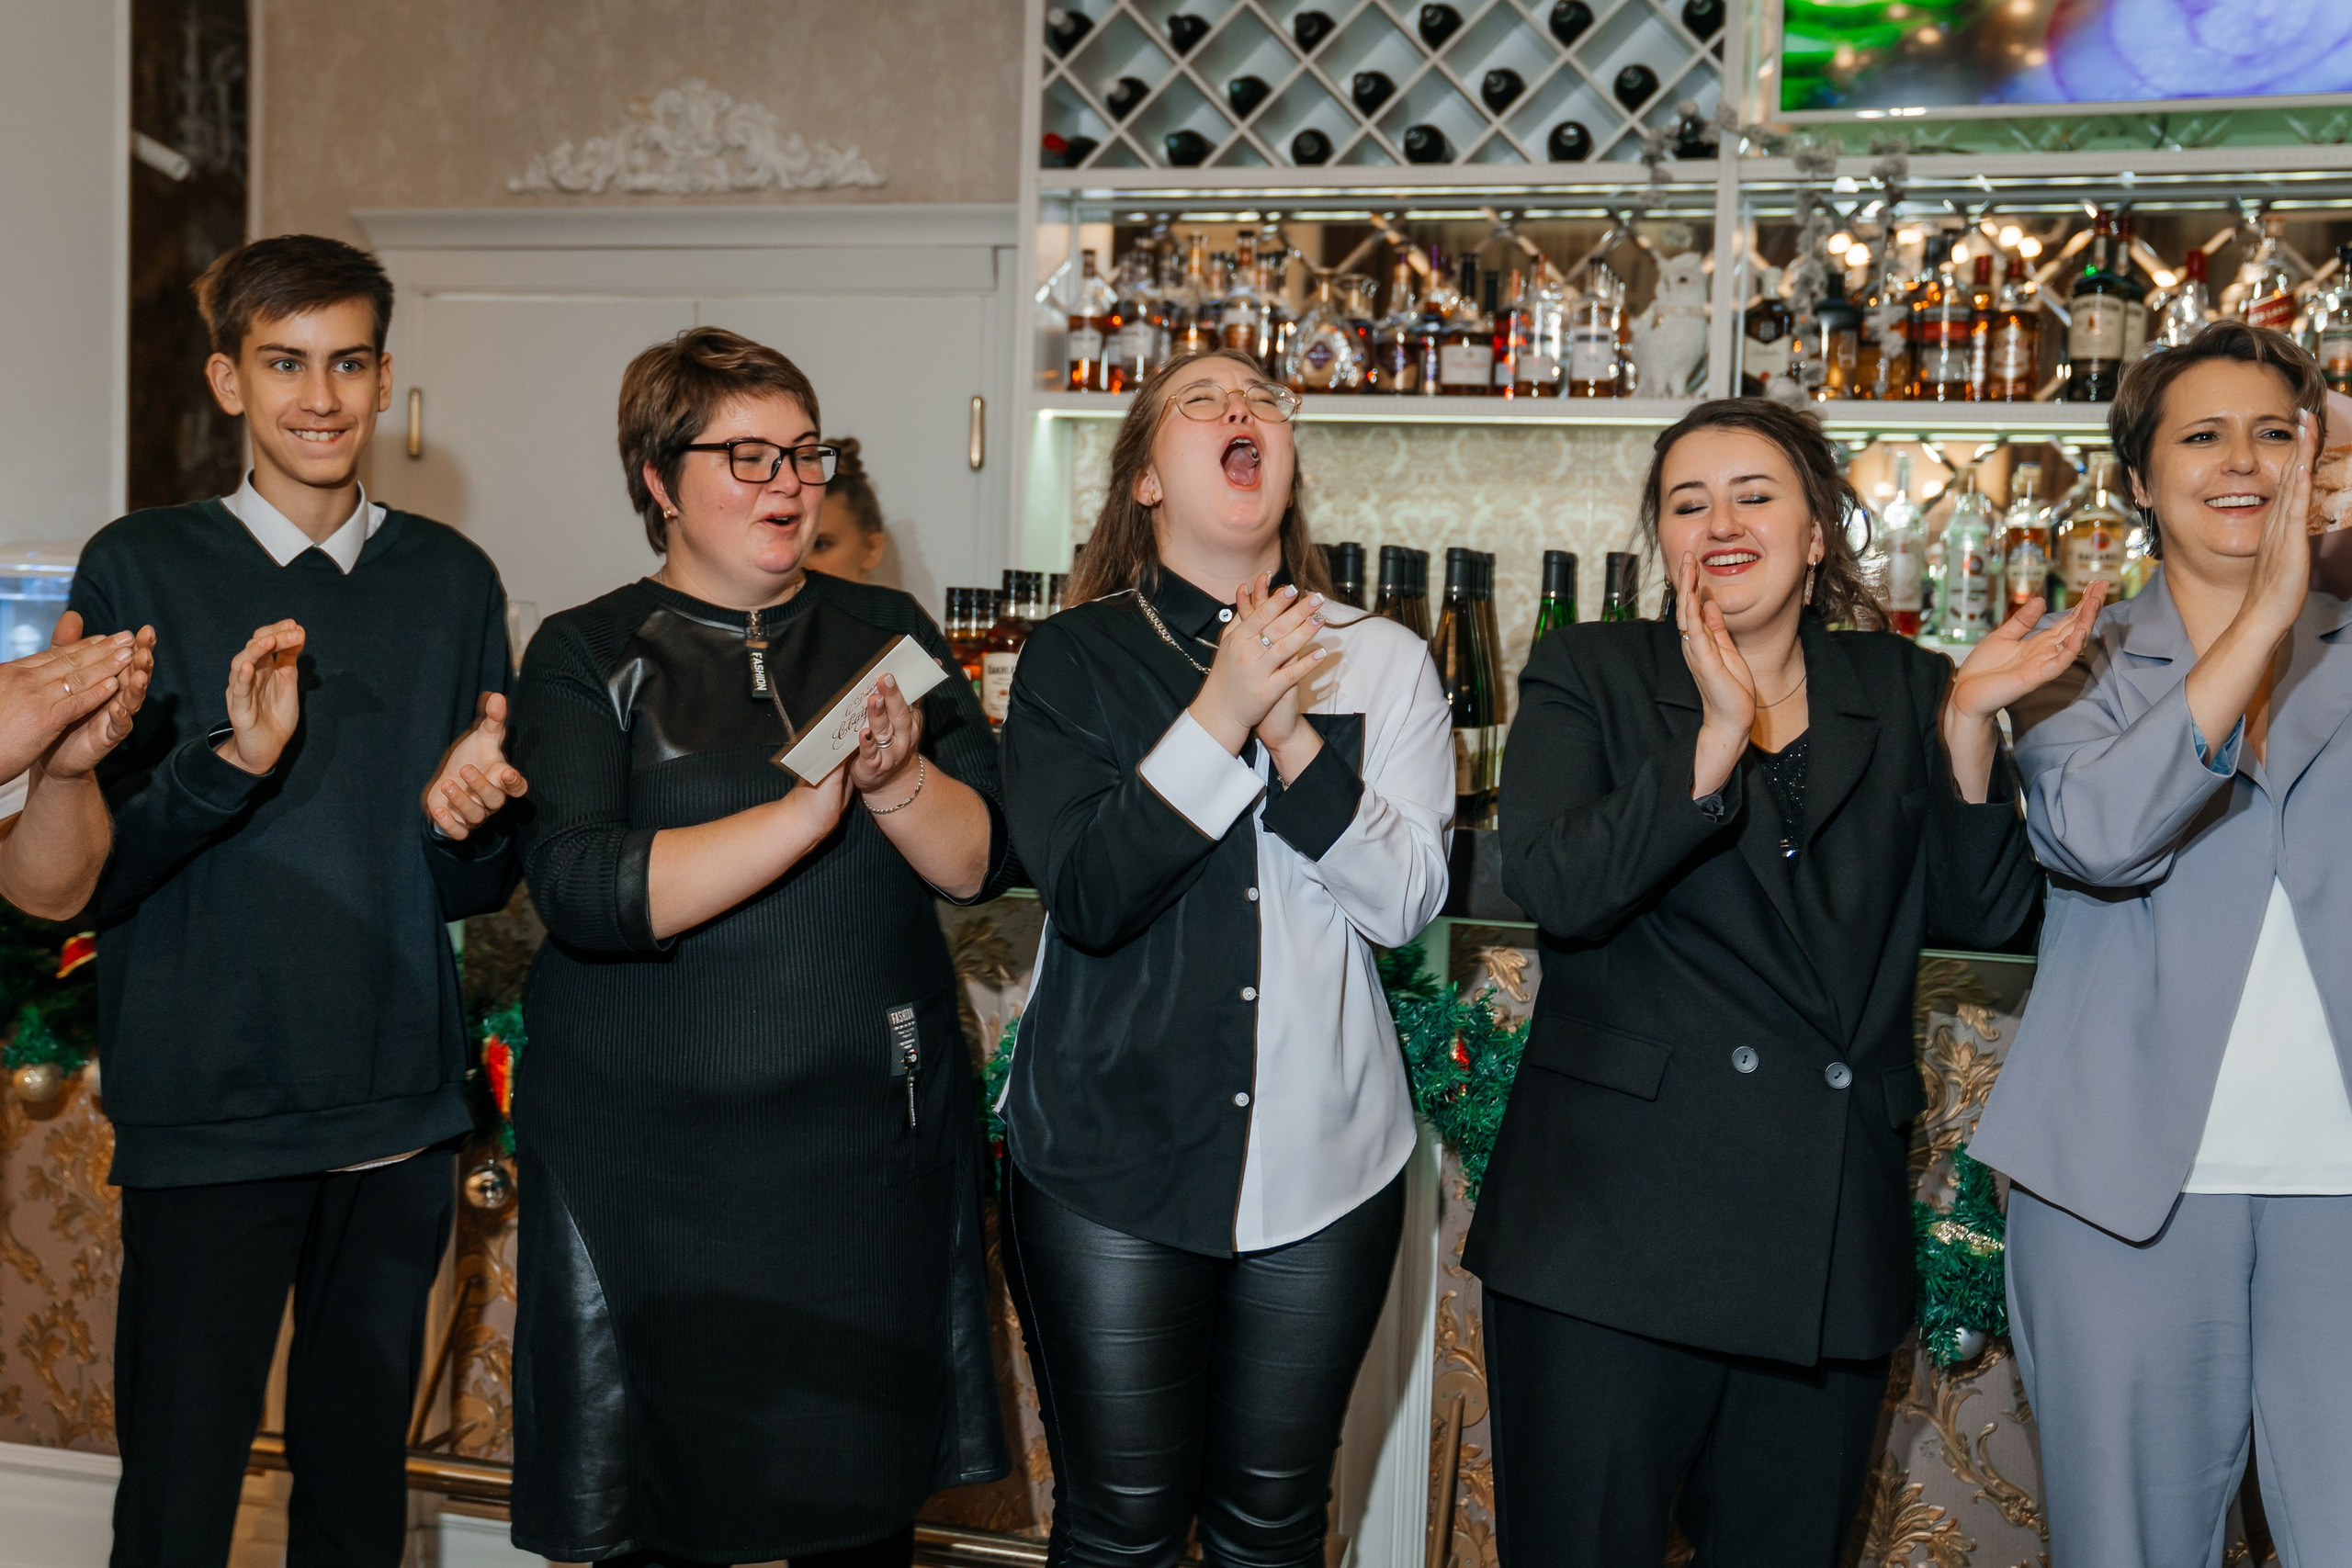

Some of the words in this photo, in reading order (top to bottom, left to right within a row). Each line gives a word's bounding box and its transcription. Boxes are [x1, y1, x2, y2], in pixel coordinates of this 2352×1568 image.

[752, 651, 768, 691] FASHION
[831, 705, 868, 750] Свад
[890, 1008, 915, 1025] FASHION
